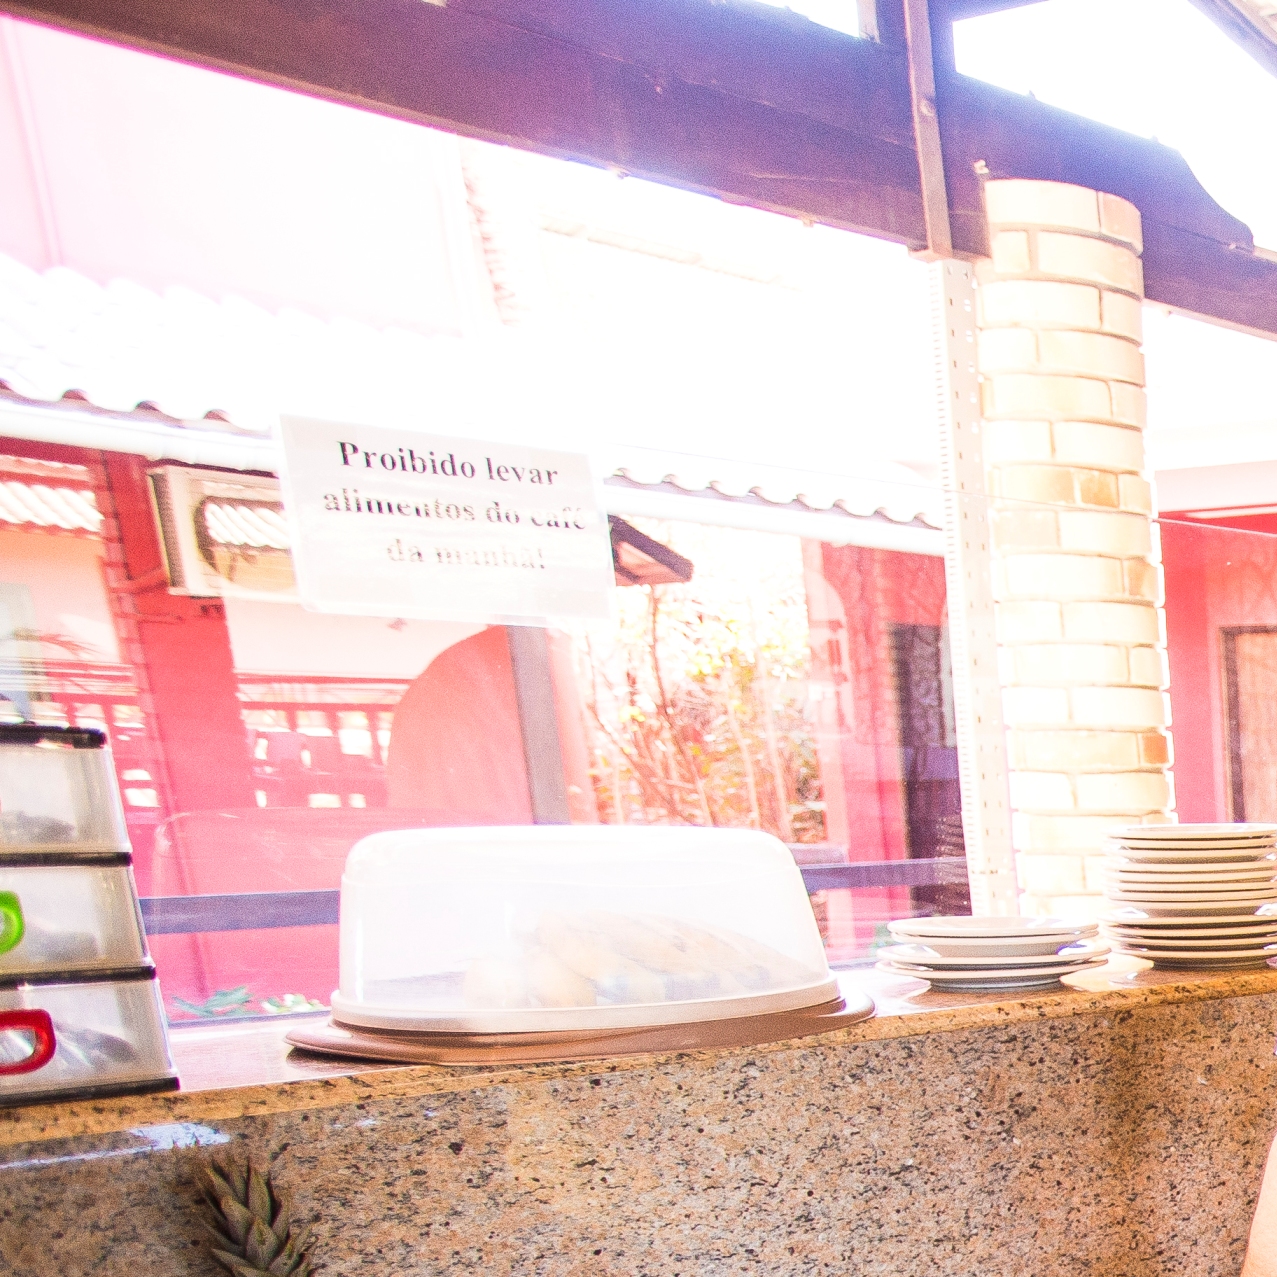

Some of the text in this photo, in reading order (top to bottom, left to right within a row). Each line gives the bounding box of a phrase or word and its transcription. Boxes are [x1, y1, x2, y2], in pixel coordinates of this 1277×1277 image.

[337, 440, 558, 485] Proibido levar
[323, 488, 586, 530] alimentos do café
[386, 538, 424, 563] da
